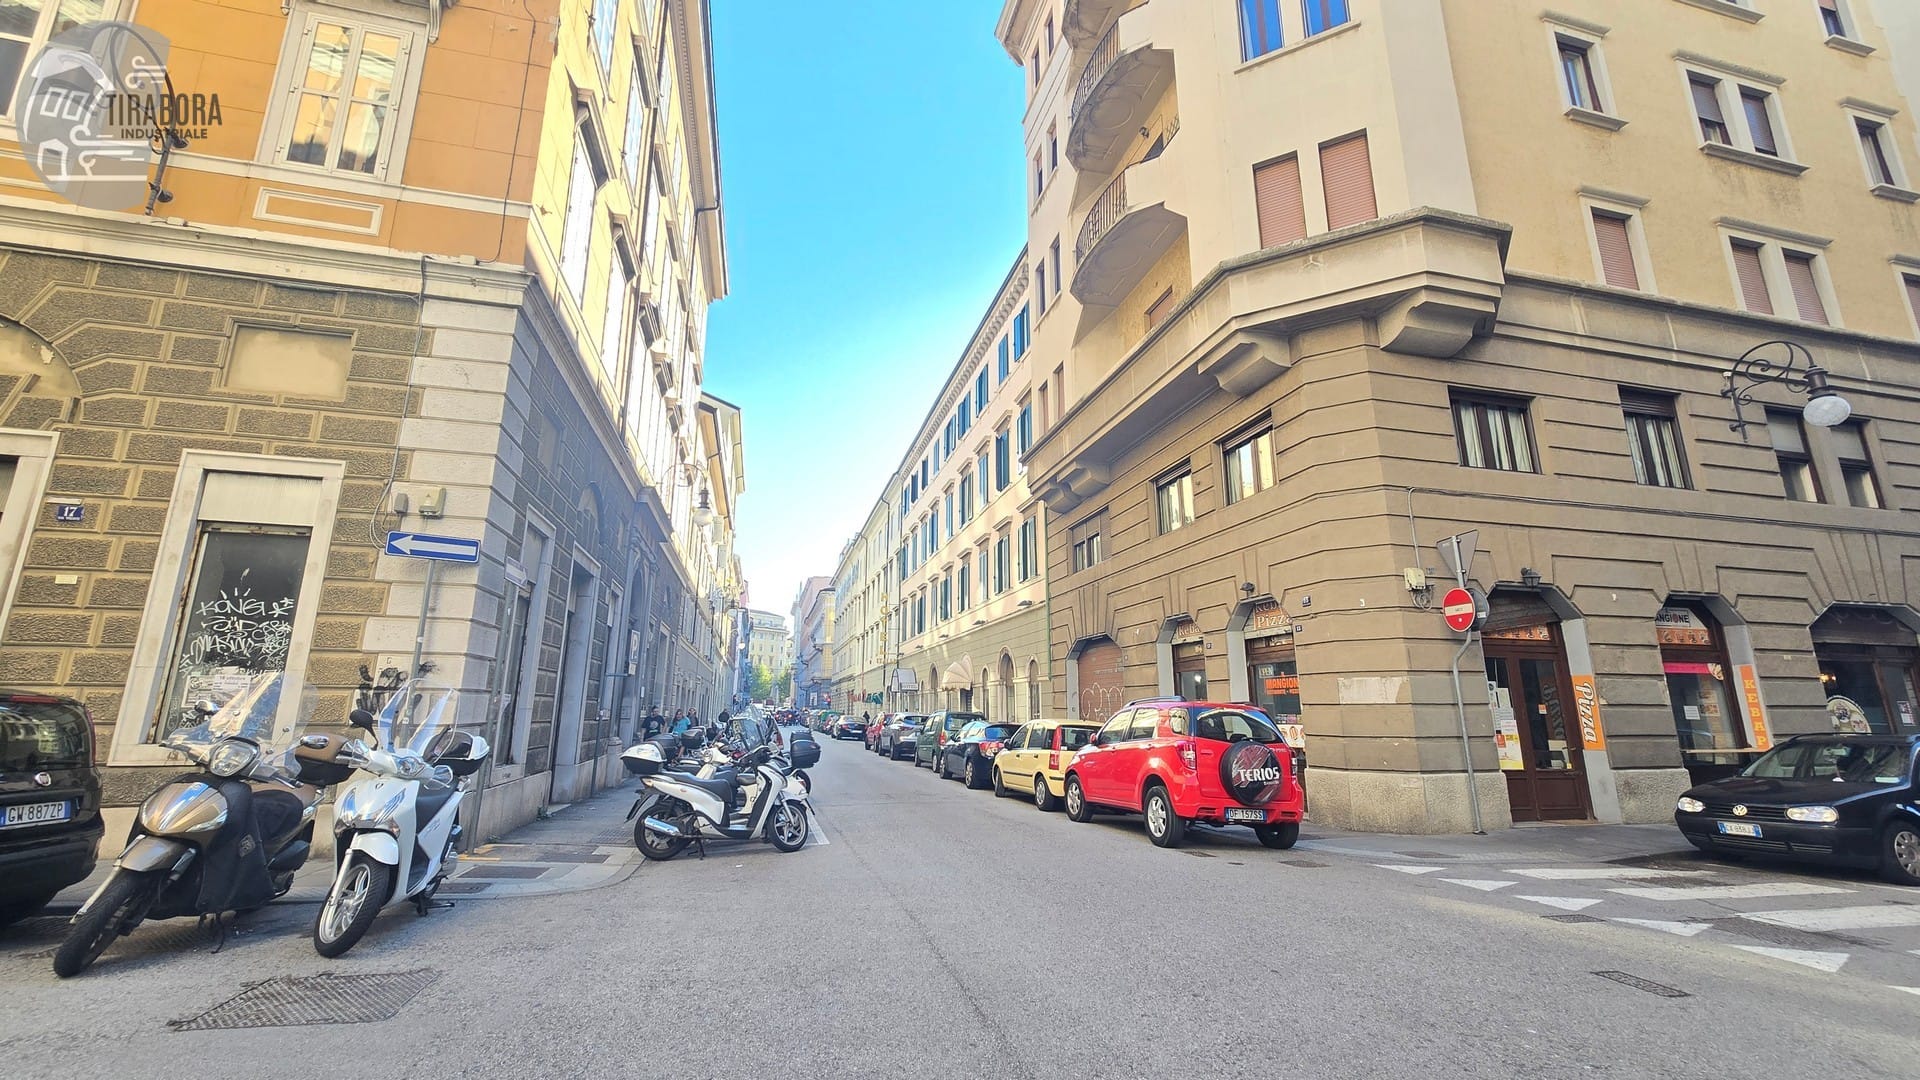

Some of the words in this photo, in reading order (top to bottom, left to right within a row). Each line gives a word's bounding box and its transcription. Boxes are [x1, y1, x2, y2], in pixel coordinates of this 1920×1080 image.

[63, 506, 78, 517] 17
[1575, 682, 1598, 743] Pizza
[1743, 679, 1766, 746] KEBAP
[1238, 767, 1280, 782] TERIOS
